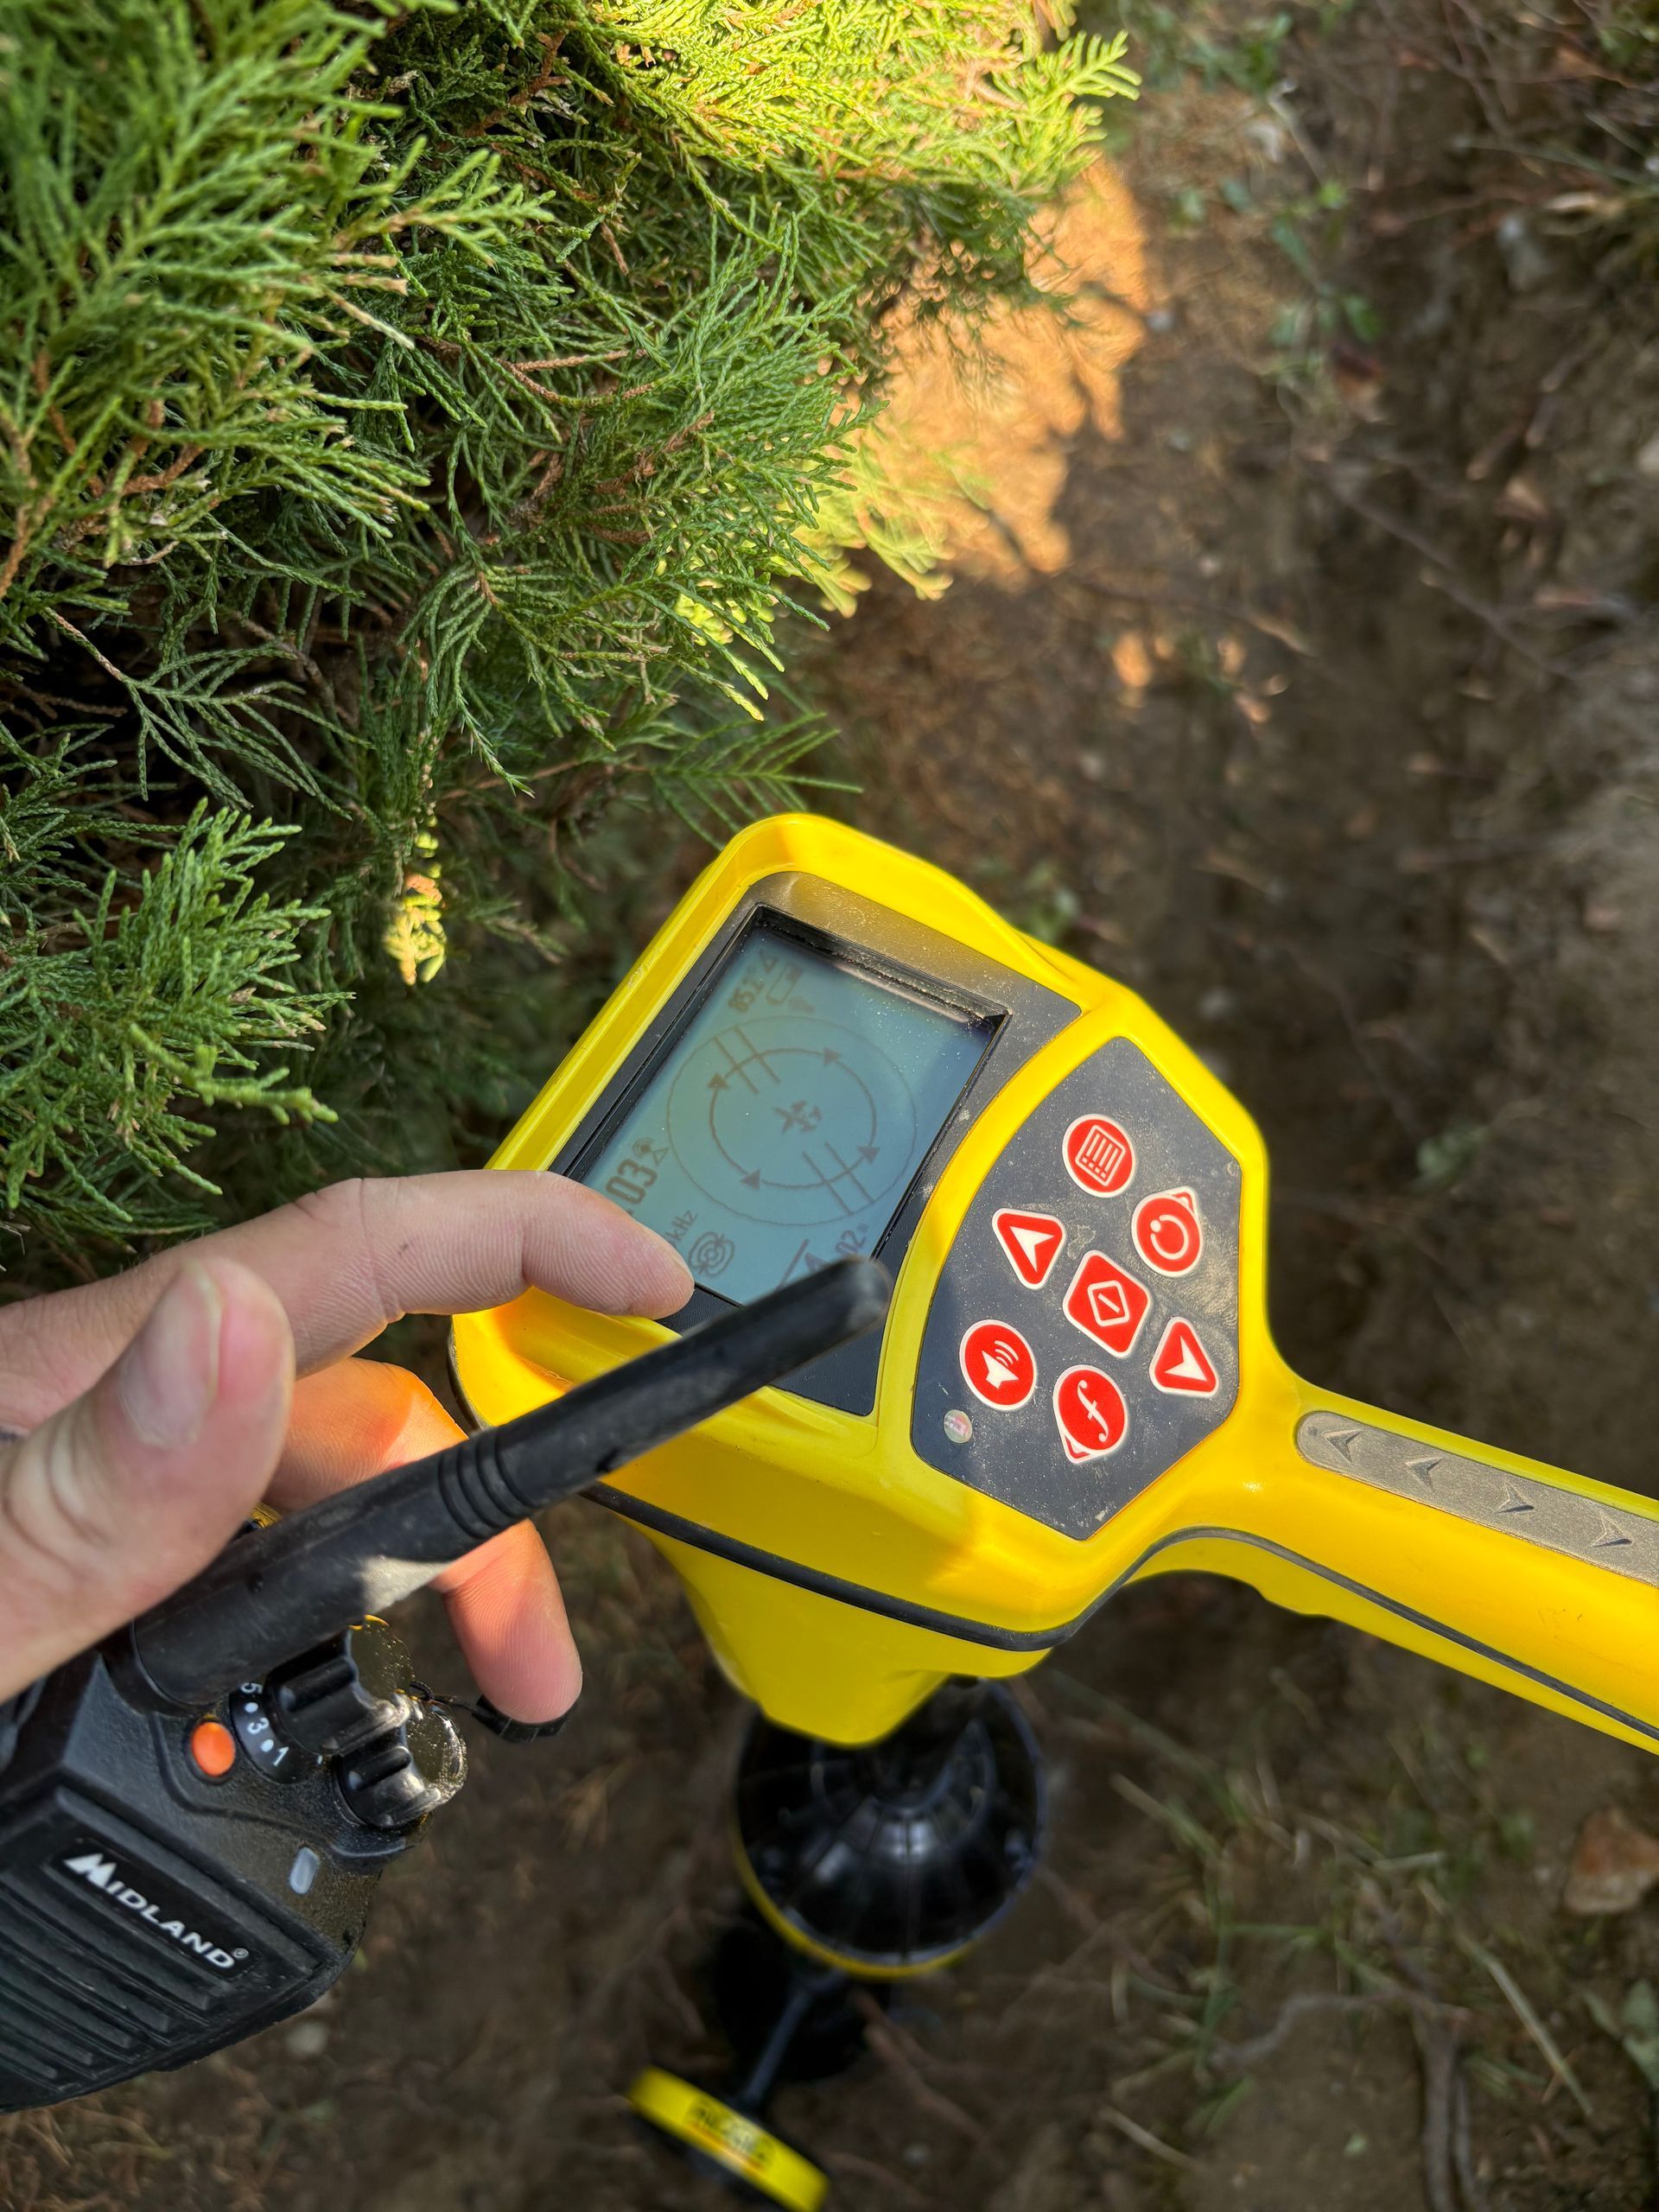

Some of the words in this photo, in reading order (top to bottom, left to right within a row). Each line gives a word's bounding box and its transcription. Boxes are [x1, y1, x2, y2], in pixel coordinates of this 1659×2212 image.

[663, 1211, 698, 1246] kHz
[247, 1717, 270, 1735] 3
[273, 1746, 289, 1767] 1
